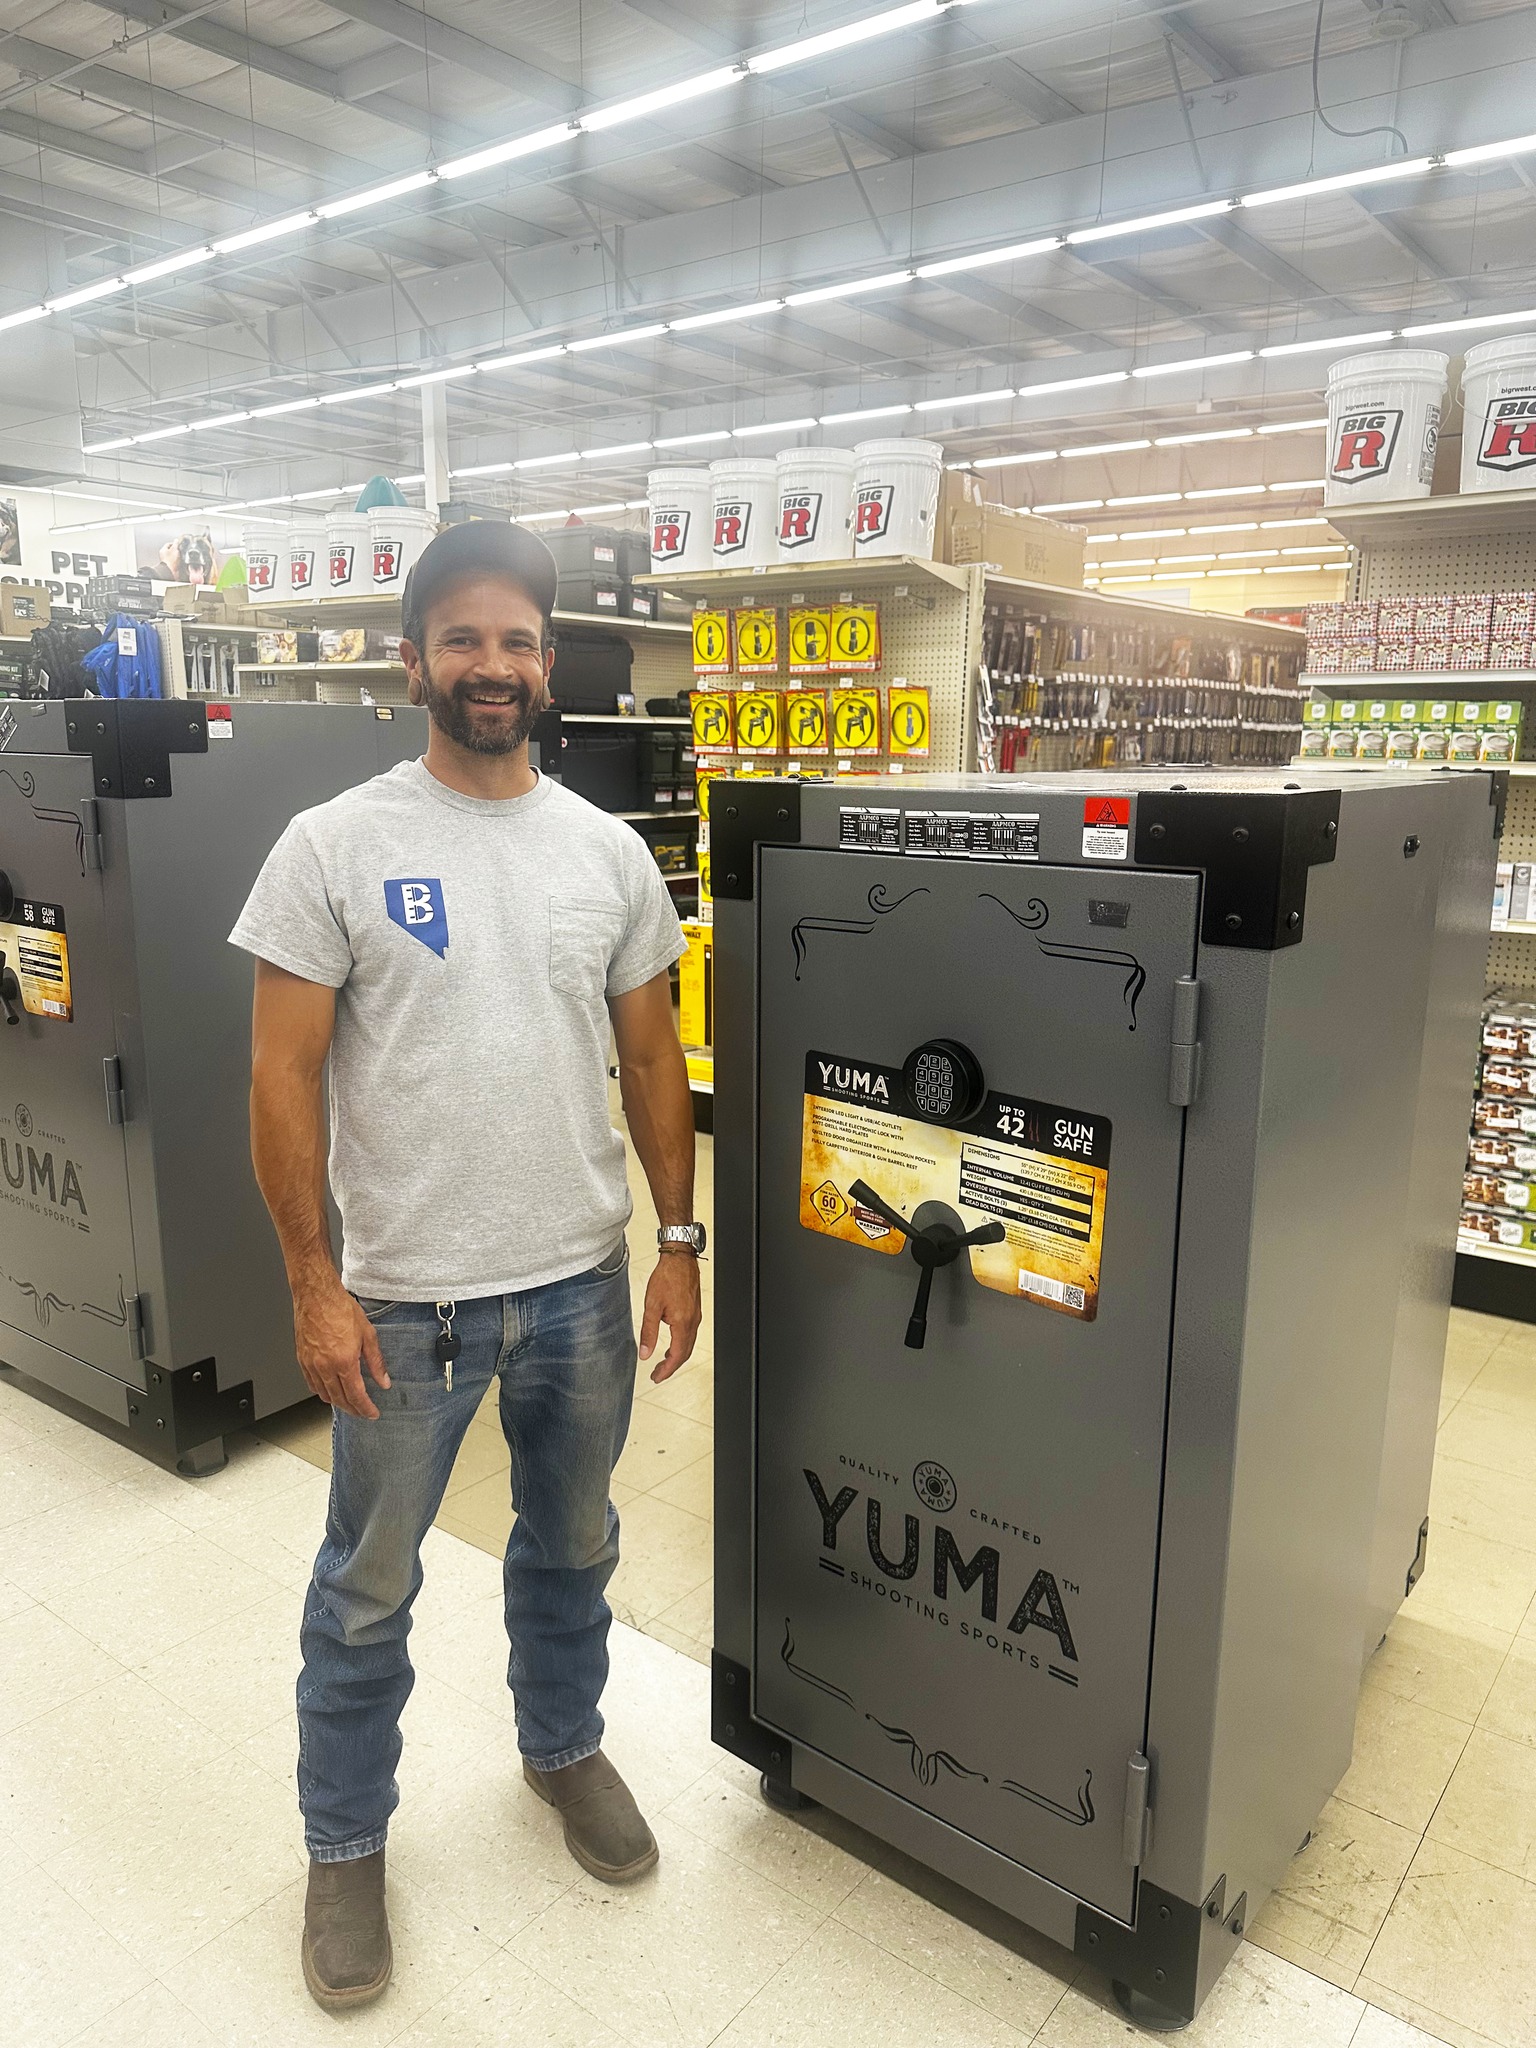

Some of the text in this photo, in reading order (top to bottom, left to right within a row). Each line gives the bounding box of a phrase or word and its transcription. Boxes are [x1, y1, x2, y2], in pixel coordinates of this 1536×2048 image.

[1342, 415, 1386, 433] BIG
[1334, 430, 1385, 472] R
[784, 496, 810, 509] BIG
[858, 490, 882, 504] BIG
[655, 514, 680, 524] BIG
[716, 506, 740, 518] BIG
[856, 502, 882, 534] R
[714, 516, 741, 546] R
[780, 508, 810, 540] R
[652, 524, 680, 552] R
[290, 554, 306, 562] BIG
[330, 549, 346, 558] BIG
[374, 544, 394, 553] BIG
[51, 550, 108, 576] PET
[250, 556, 268, 564] BIG
[330, 557, 348, 580] R
[373, 553, 394, 576] R
[250, 564, 270, 584] R
[290, 561, 308, 582] R
[42, 907, 55, 917] GUN
[400, 883, 434, 925] B
[24, 909, 34, 921] 58
[42, 916, 55, 925] SAFE
[818, 1061, 889, 1098] YUMA
[832, 1087, 881, 1103] SHOOTING SPORTS
[813, 1104, 835, 1115] INTERIOR
[845, 1112, 859, 1121] LIGHT
[881, 1121, 902, 1131] OUTLETS
[1000, 1104, 1025, 1118] UP TO
[812, 1114, 904, 1141] PROGRAMMABLE ELECTRONIC LOCK WITH
[839, 1126, 851, 1134] HARD
[852, 1129, 868, 1138] PLATES
[996, 1115, 1025, 1139] 42
[1054, 1119, 1094, 1142] GUN
[812, 1129, 832, 1139] QUILTED
[833, 1134, 845, 1143] DOOR
[846, 1138, 873, 1150] ORGANIZER
[873, 1145, 886, 1153] WITH
[891, 1149, 914, 1160] HANDGUN
[915, 1155, 936, 1166] POCKETS
[812, 1138, 825, 1146] FULLY
[826, 1141, 848, 1152] CARPETED
[849, 1148, 871, 1158] INTERIOR
[888, 1158, 905, 1167] BARREL
[906, 1163, 918, 1171] REST
[968, 1148, 1000, 1160] DIMENSIONS
[1053, 1134, 1093, 1156] SAFE
[966, 1173, 986, 1182] WEIGHT
[967, 1164, 1014, 1181] INTERNAL VOLUME
[822, 1195, 836, 1209] 60
[965, 1190, 983, 1199] ACTIVE
[984, 1195, 1000, 1204] BOLTS
[980, 1203, 995, 1212] BOLTS
[44, 1208, 76, 1228] SPORTS
[859, 1222, 886, 1232] WARRANTY
[1060, 1218, 1073, 1226] STEEL
[839, 1455, 899, 1486] QUALITY
[918, 1466, 948, 1486] YUMA
[921, 1488, 950, 1507] YUMA
[970, 1508, 1042, 1545] CRAFTED
[802, 1468, 1078, 1662] YUMA
[851, 1572, 1040, 1669] SHOOTING SPORTS
